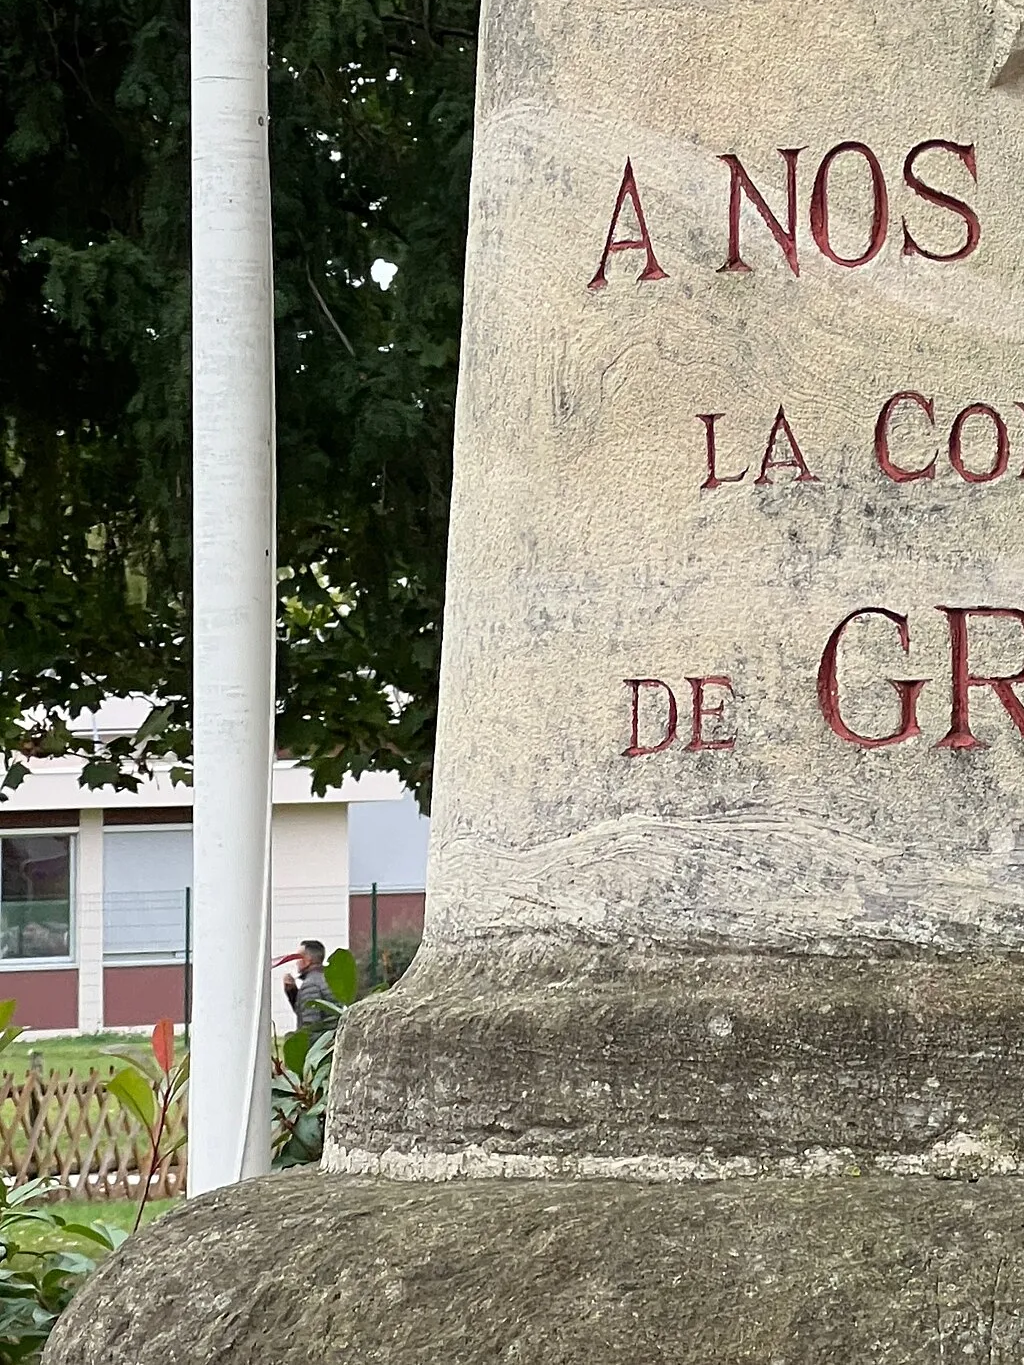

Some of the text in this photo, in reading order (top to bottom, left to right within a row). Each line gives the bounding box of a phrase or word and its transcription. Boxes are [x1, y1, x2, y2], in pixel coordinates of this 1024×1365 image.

[586, 156, 670, 289] A
[714, 138, 981, 278] NOS
[695, 405, 820, 491] LA
[619, 674, 737, 758] DE
